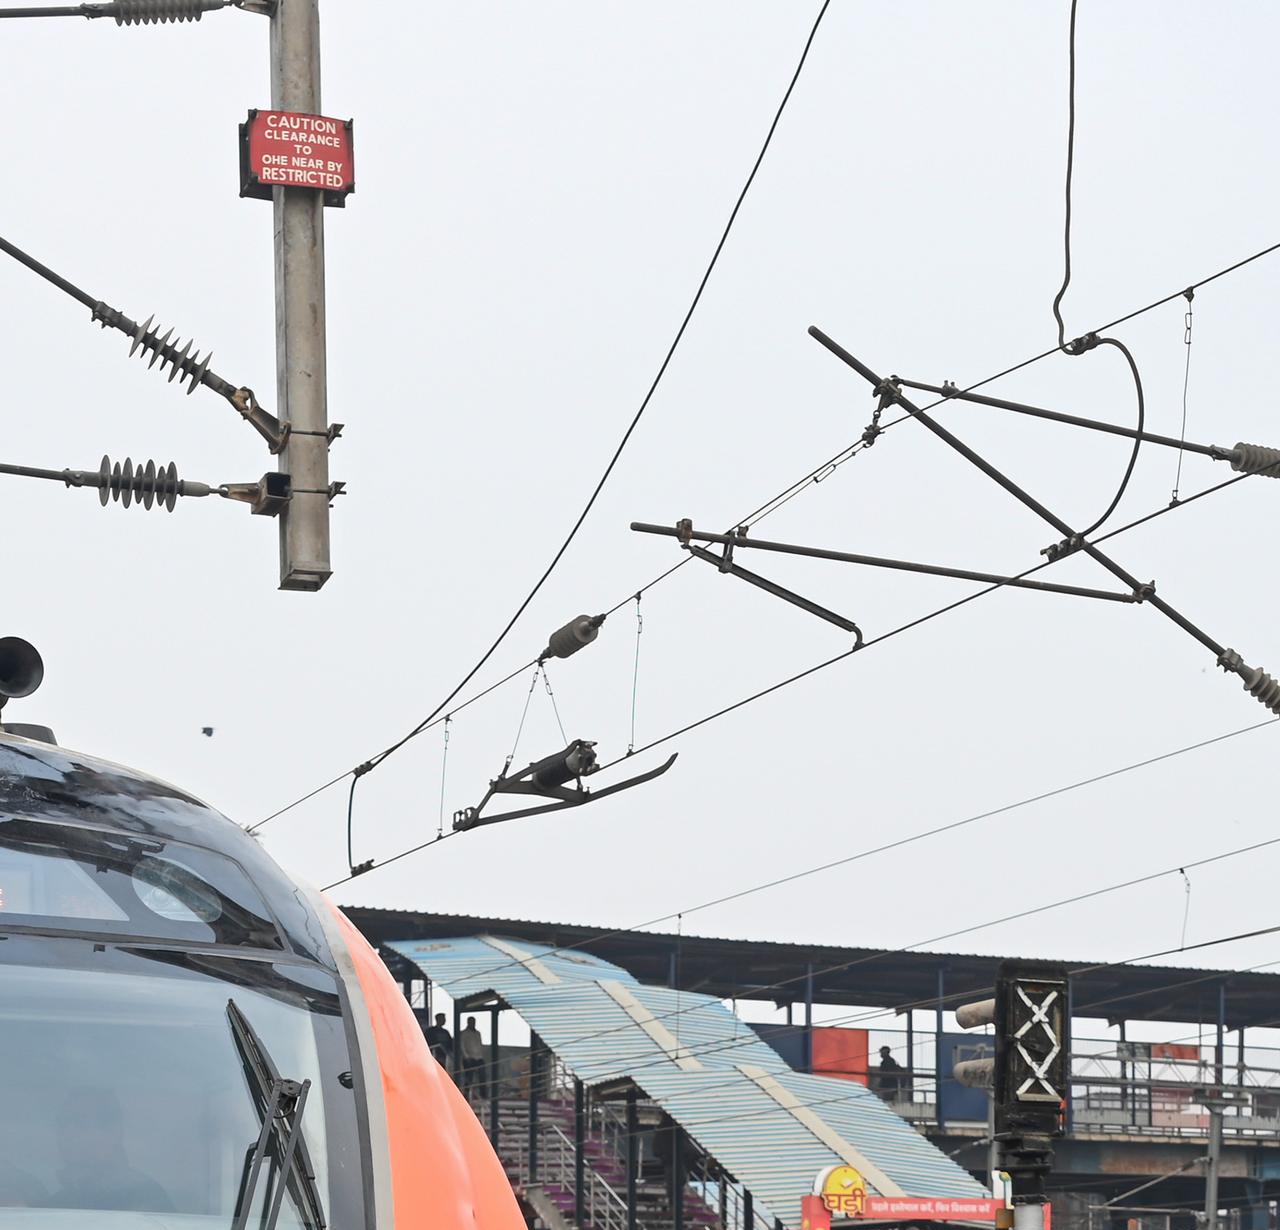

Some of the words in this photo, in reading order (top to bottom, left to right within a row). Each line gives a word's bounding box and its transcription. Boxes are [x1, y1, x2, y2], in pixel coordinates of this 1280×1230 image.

[266, 115, 336, 134] CAUTION
[264, 130, 340, 147] CLEARANCE
[294, 144, 312, 155] TO
[261, 155, 288, 166] OHE
[291, 156, 324, 170] NEAR
[327, 162, 342, 172] BY
[262, 167, 343, 187] RESTRICTED
[823, 1188, 867, 1218] घड़ी
